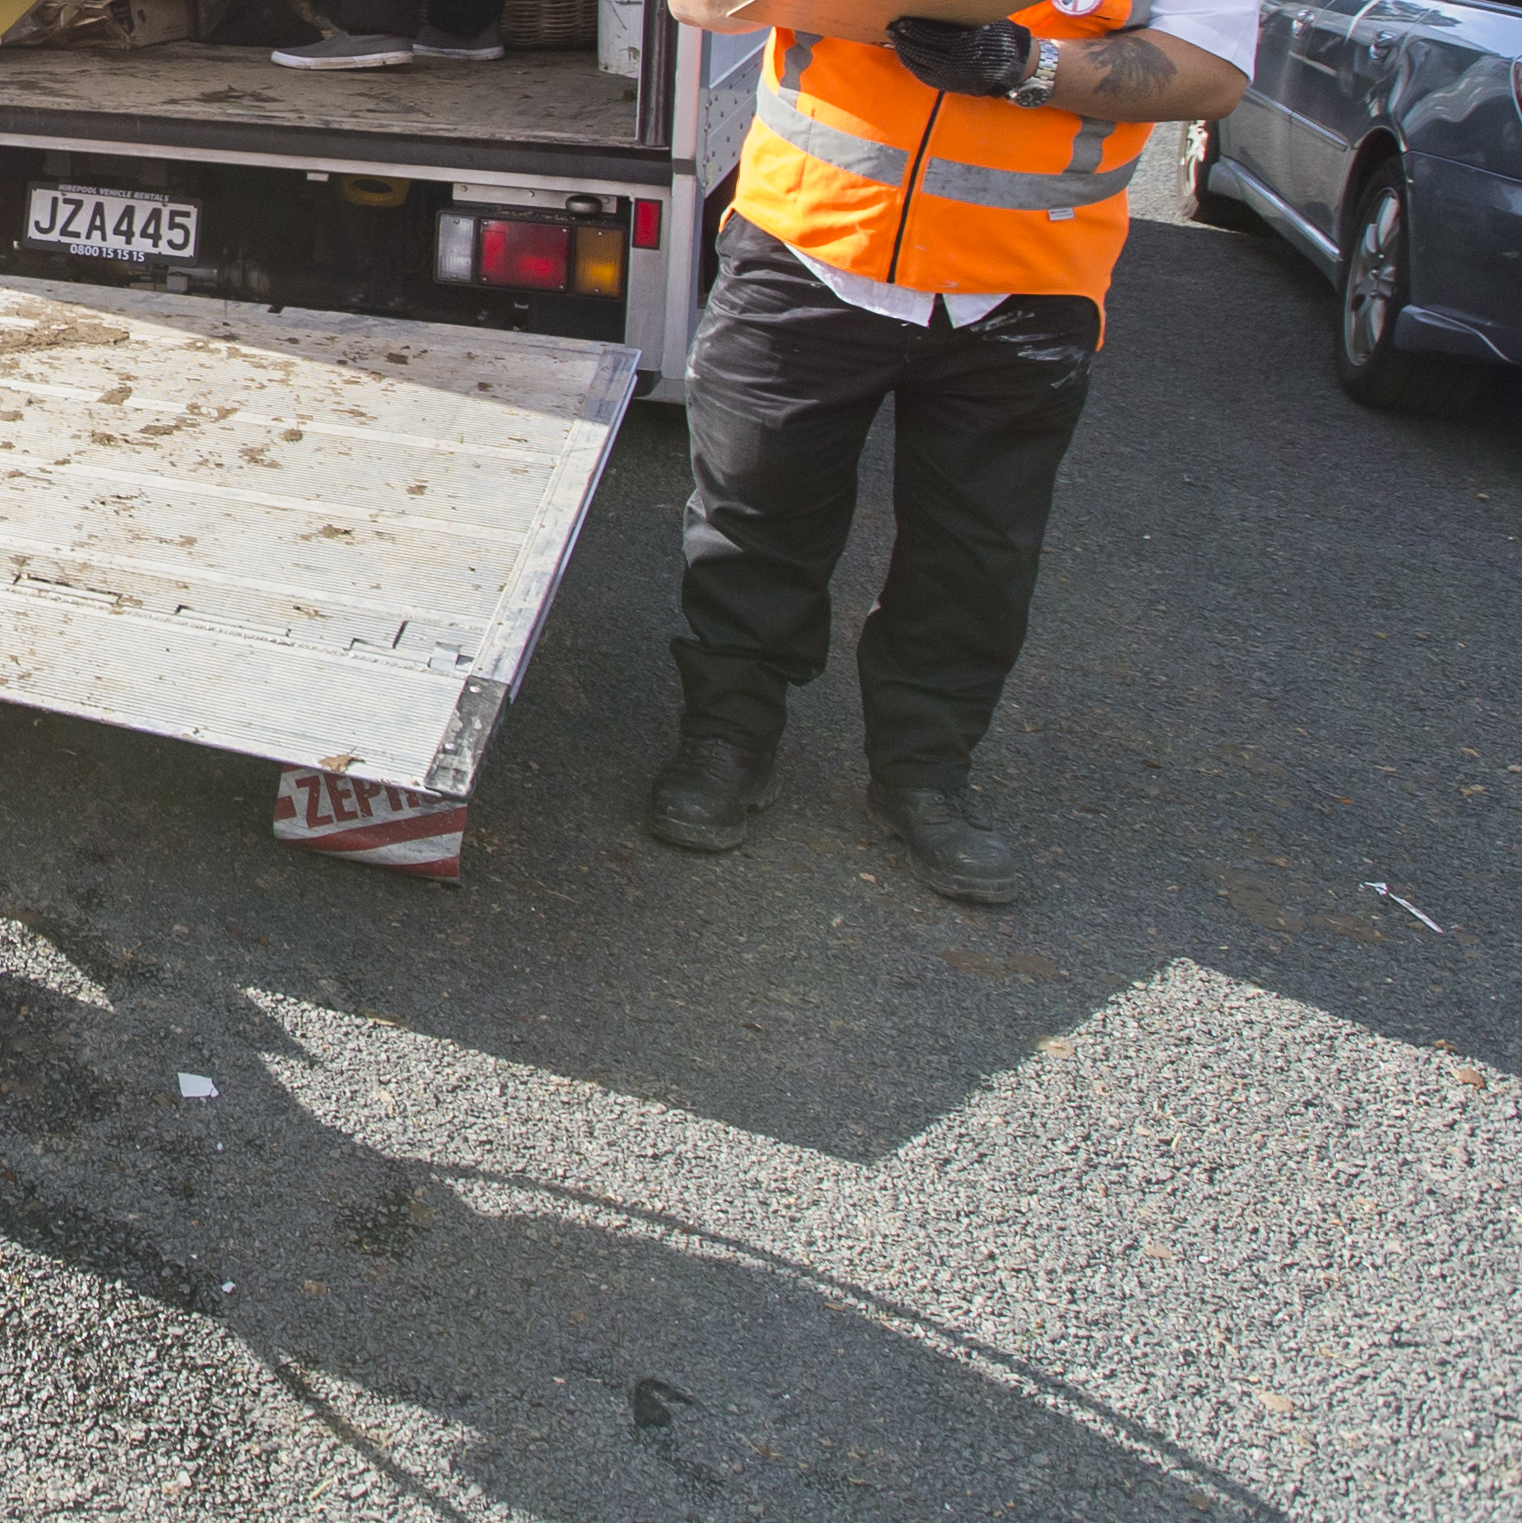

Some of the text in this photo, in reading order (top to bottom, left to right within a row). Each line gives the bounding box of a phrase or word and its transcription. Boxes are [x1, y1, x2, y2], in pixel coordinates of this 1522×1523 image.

[58, 183, 170, 203] HIREPOOL VEHICLE RENTALS
[34, 195, 192, 252] JZA445
[69, 243, 146, 263] 0800 15 15 15
